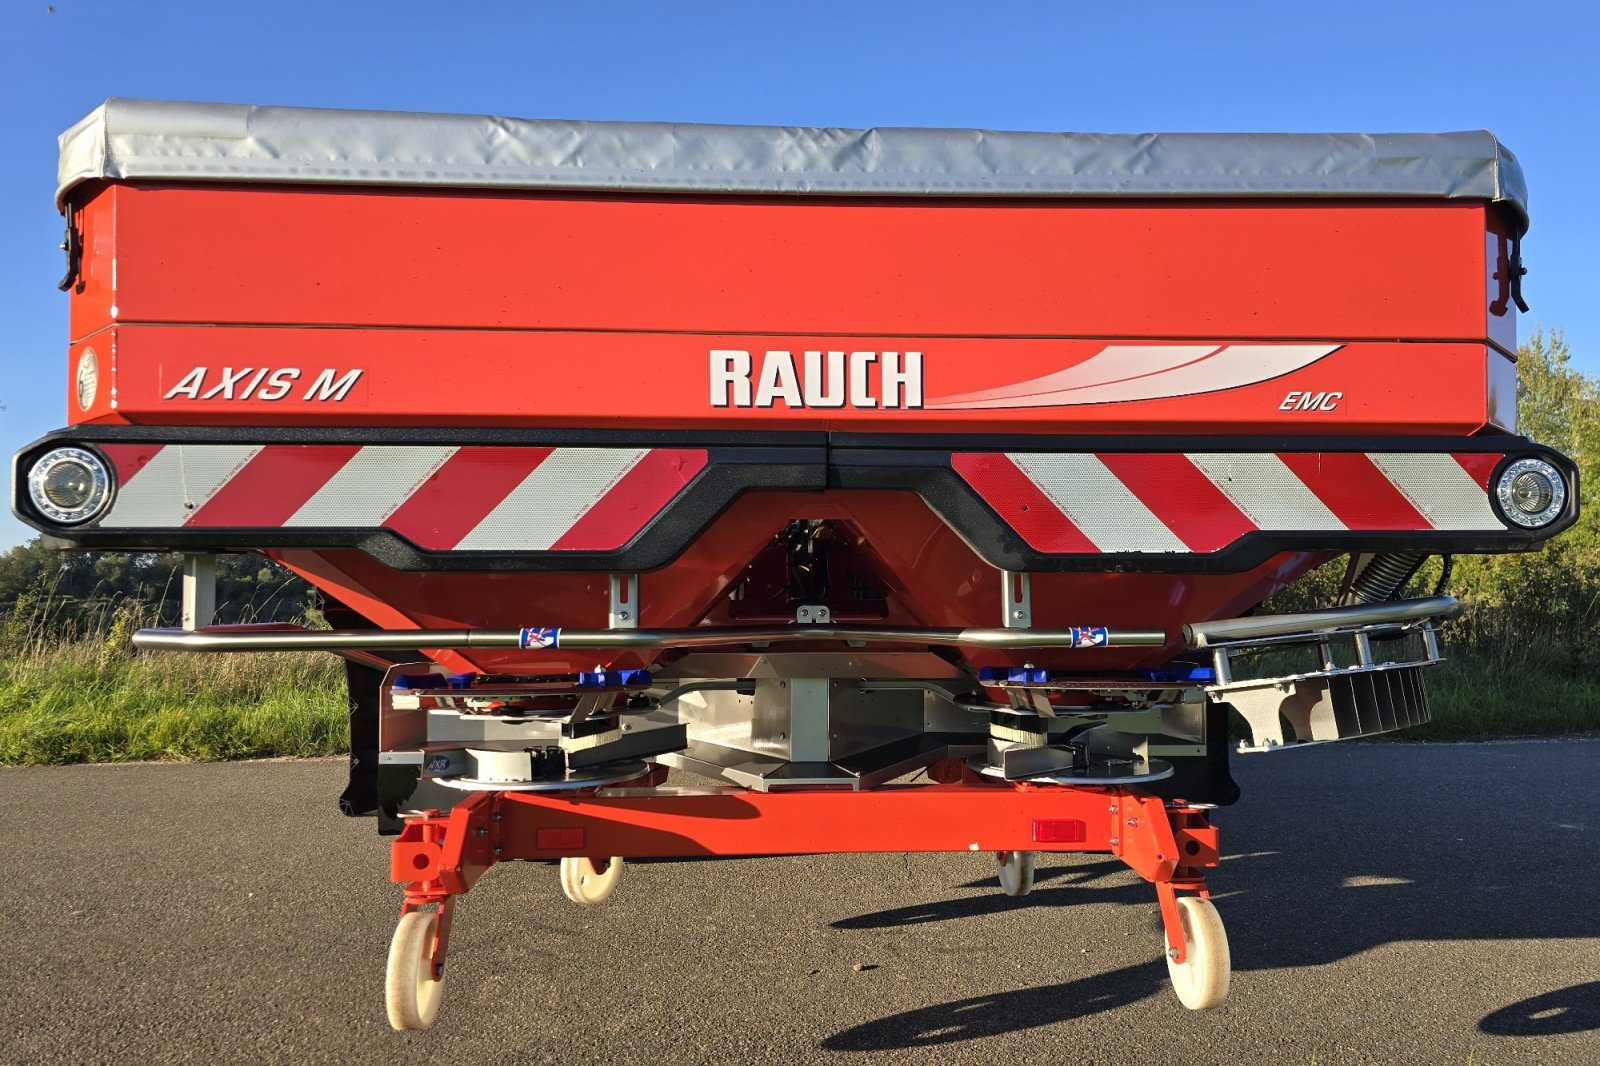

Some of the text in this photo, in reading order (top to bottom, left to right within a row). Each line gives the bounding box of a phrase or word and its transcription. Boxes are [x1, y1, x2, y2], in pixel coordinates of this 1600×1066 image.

[163, 366, 364, 402] AXIS M
[709, 349, 924, 409] RAUCH
[1278, 391, 1343, 411] EMC
